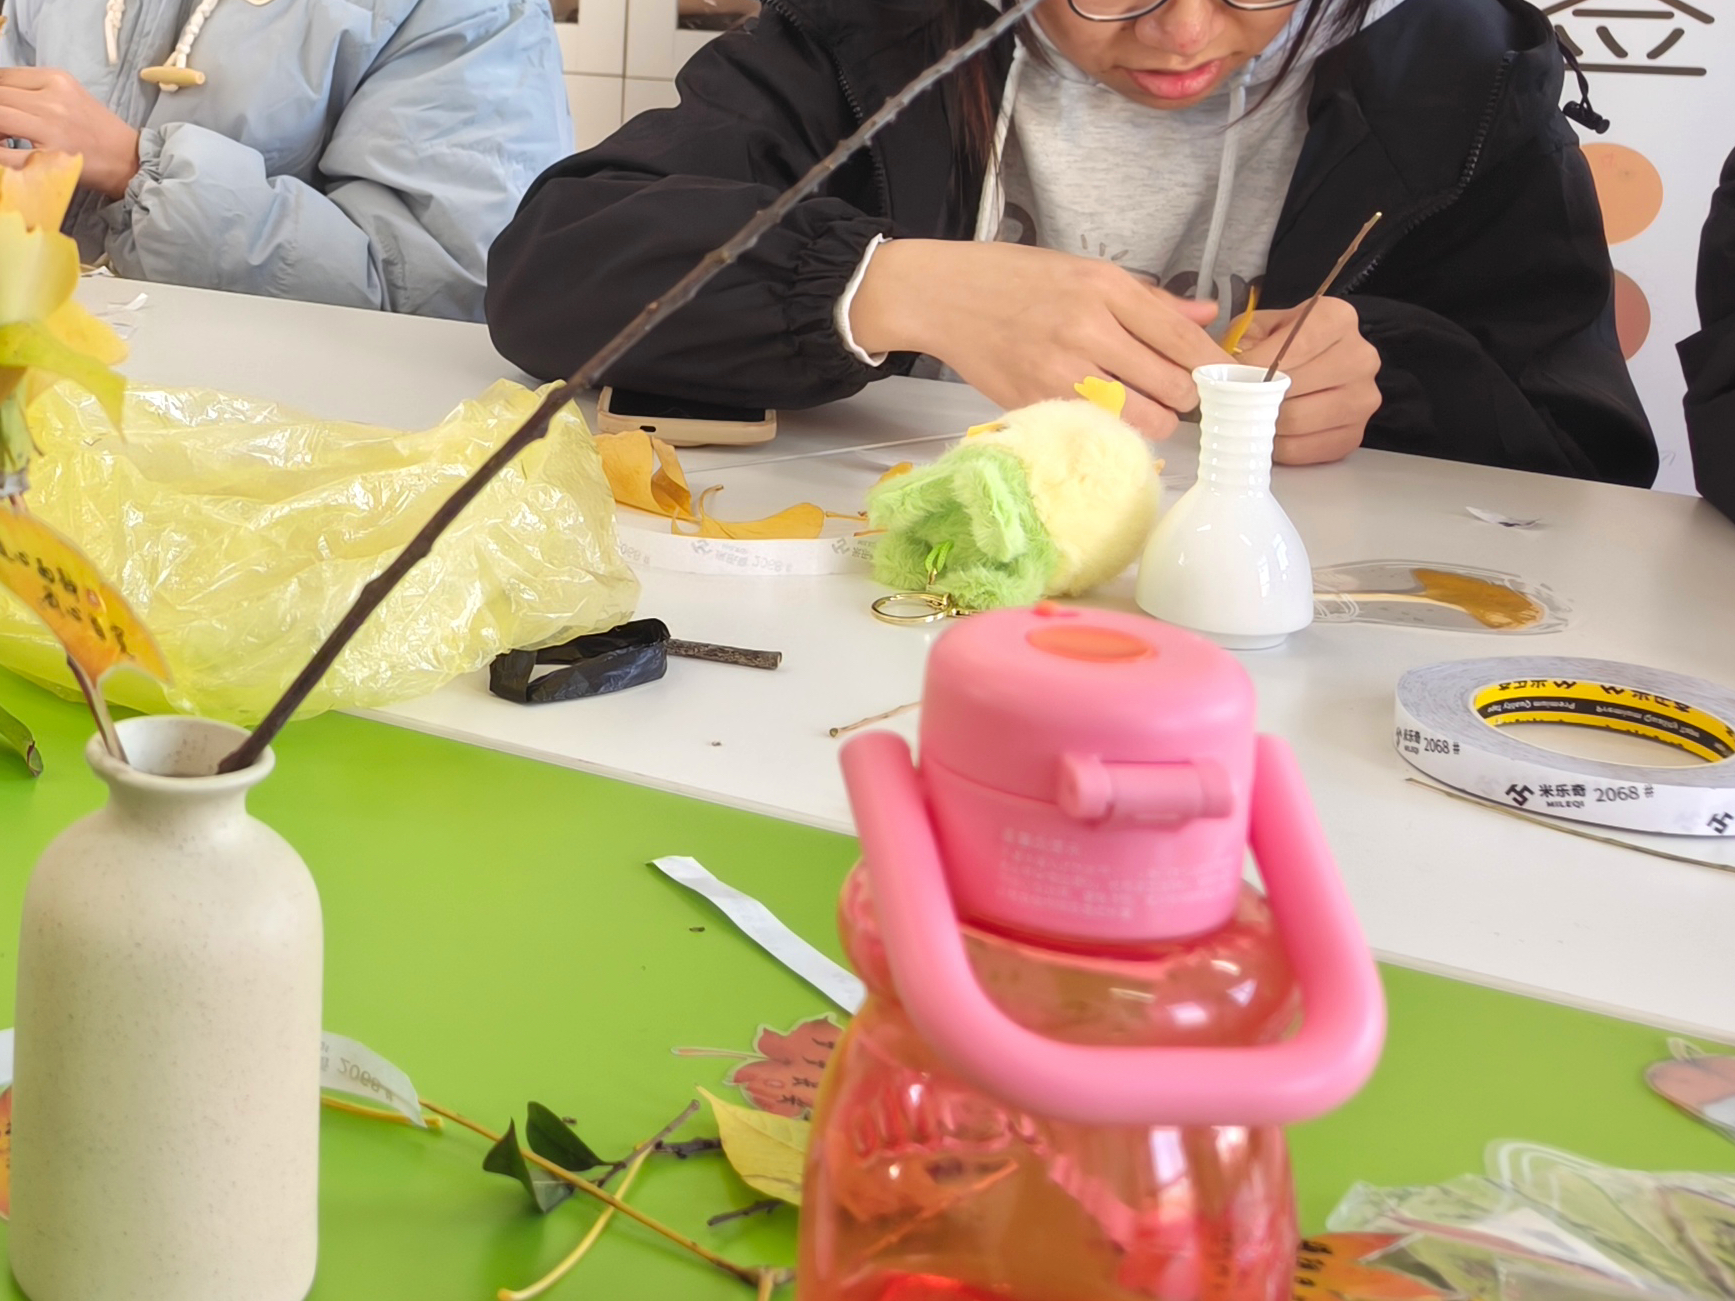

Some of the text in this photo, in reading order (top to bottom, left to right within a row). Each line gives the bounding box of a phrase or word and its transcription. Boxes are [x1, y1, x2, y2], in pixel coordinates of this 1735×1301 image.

[1423, 737, 1450, 755] 2068
[1539, 784, 1586, 798] 米乐奇
[1594, 786, 1640, 803] 2068
